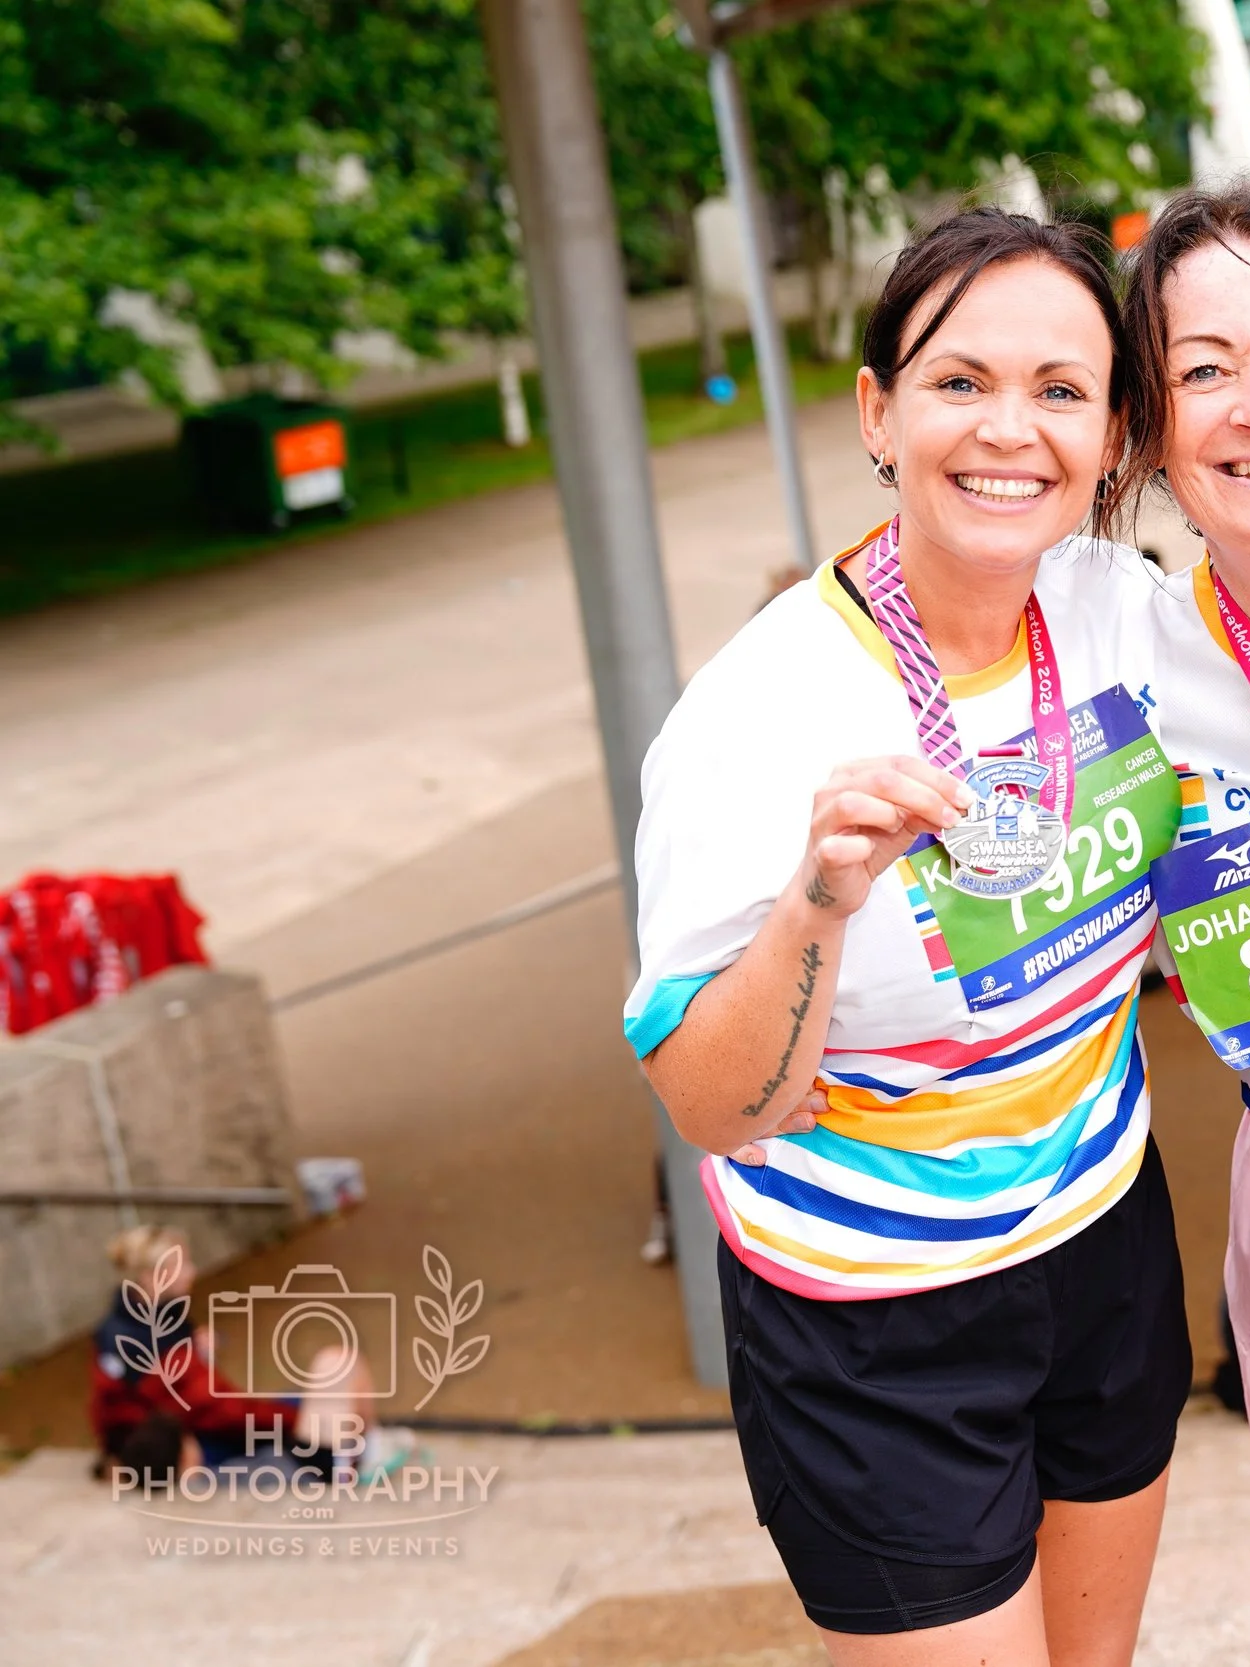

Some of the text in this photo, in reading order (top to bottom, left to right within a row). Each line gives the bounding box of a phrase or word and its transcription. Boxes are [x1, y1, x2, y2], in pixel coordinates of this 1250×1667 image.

[1037, 666, 1054, 716] 2026
[1125, 747, 1159, 772] CANCER
[1093, 762, 1166, 808] RESEARCH WALES
[969, 839, 1048, 856] SWANSEA
[959, 867, 1044, 894] #RUNSWANSEA
[997, 866, 1022, 878] 2026
[1022, 884, 1151, 984] #RUNSWANSEA
